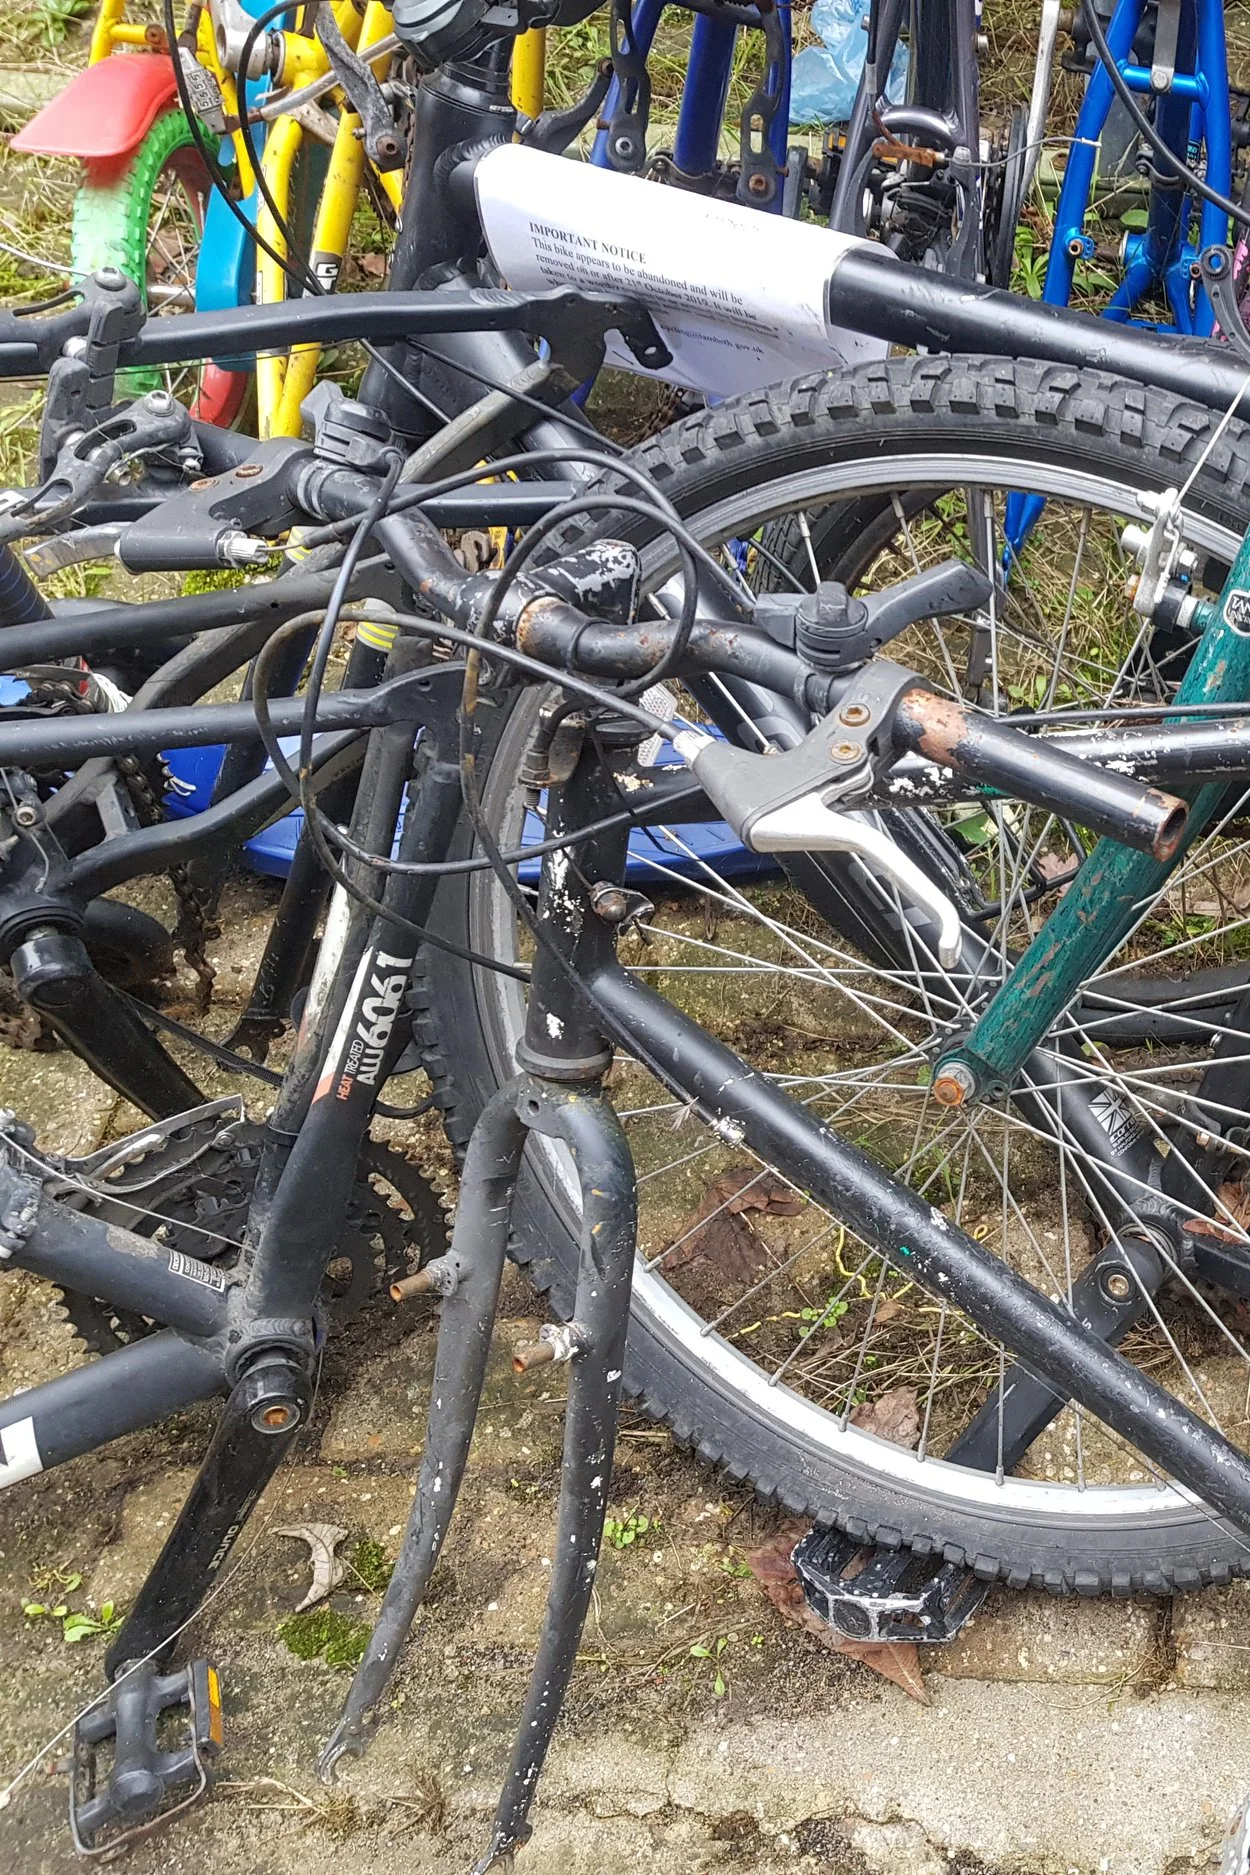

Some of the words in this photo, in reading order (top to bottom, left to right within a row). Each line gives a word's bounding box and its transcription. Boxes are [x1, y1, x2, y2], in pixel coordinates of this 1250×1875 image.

[529, 221, 598, 250] IMPORTANT
[601, 242, 647, 264] NOTICE
[531, 236, 553, 252] This
[553, 242, 574, 258] bike
[576, 252, 610, 270] appears
[612, 261, 621, 272] to
[623, 263, 638, 276] be
[637, 268, 688, 291] abandoned
[690, 282, 707, 296] and
[709, 289, 728, 303] will
[730, 292, 743, 305] be
[536, 253, 575, 272] removed
[576, 265, 589, 275] on
[590, 270, 600, 279] or
[602, 273, 623, 284] after
[644, 282, 682, 300] October
[336, 1075, 353, 1100] HEAT
[345, 1039, 364, 1074] TREATED
